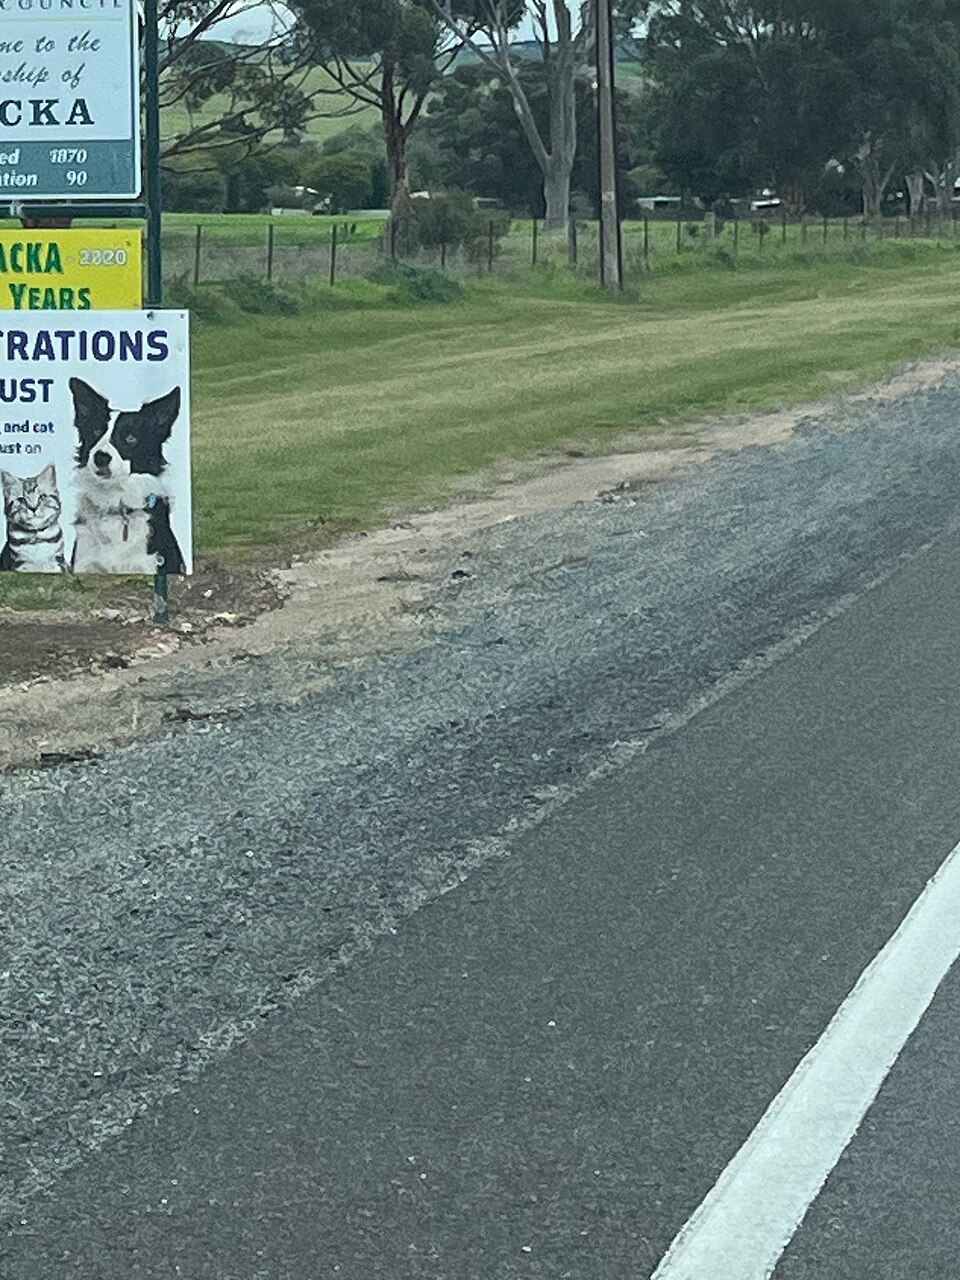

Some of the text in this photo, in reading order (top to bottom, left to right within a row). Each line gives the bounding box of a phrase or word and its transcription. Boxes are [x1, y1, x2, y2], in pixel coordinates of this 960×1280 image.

[34, 35, 56, 52] to
[68, 30, 101, 52] the
[62, 63, 85, 89] of
[50, 148, 87, 163] 1870
[66, 171, 87, 185] 90
[80, 248, 127, 265] 2020
[4, 421, 29, 433] and
[33, 422, 55, 434] cat
[25, 444, 41, 454] on
